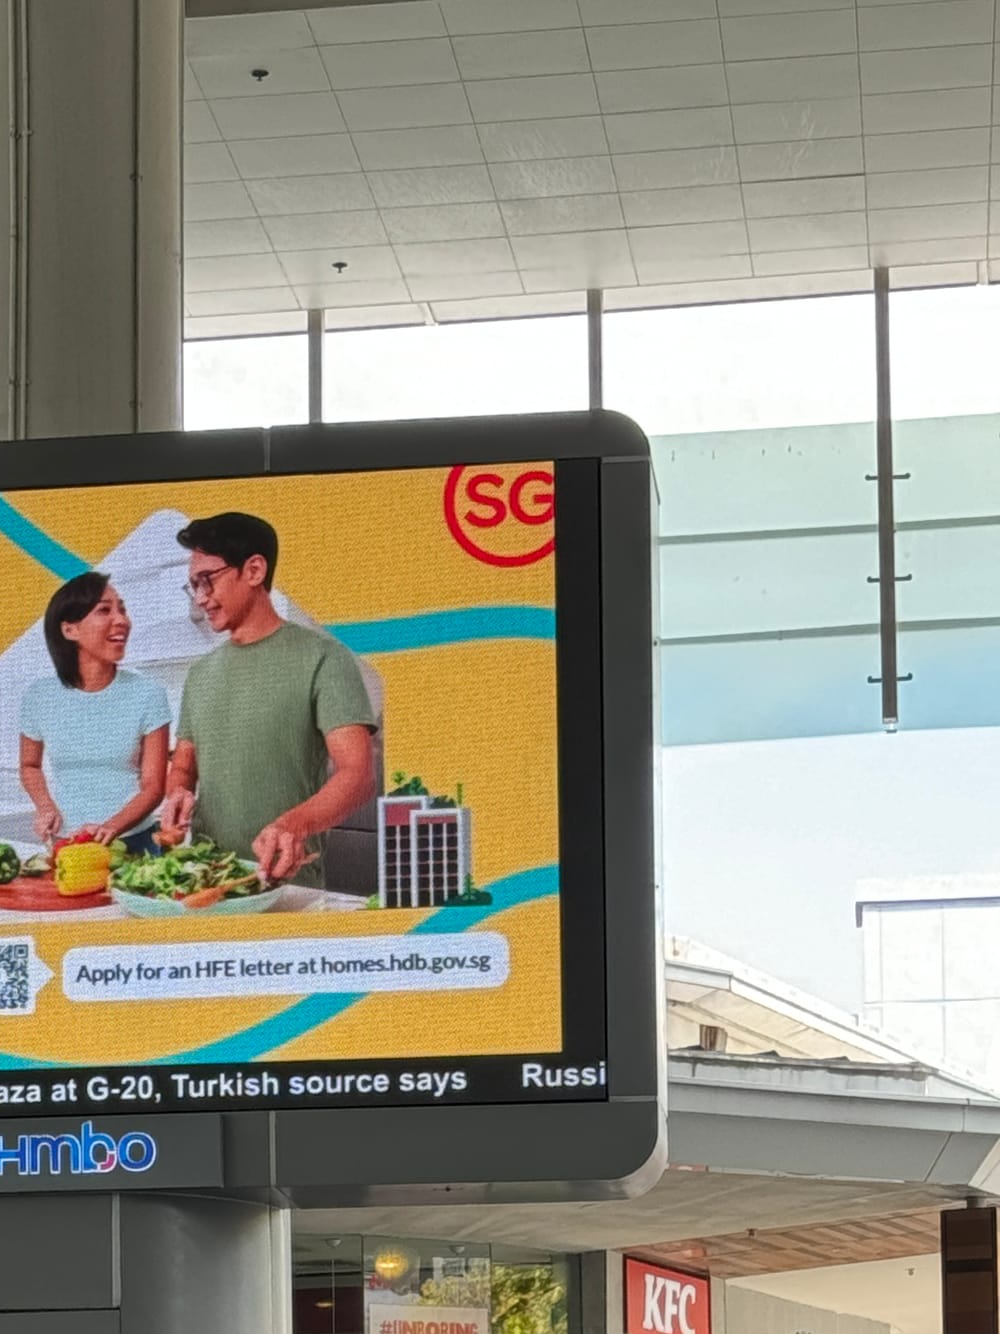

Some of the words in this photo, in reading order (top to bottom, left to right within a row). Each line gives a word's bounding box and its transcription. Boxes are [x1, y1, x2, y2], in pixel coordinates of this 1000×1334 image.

[464, 470, 555, 529] SG
[76, 965, 132, 986] Apply
[136, 961, 162, 981] for
[168, 963, 191, 979] an
[196, 959, 235, 979] HFE
[239, 957, 294, 977] letter
[297, 957, 318, 975] at
[320, 950, 490, 974] homes.hdb.gov.sg
[51, 1079, 77, 1102] at
[87, 1075, 161, 1103] G-20,
[171, 1069, 279, 1099] Turkish
[288, 1070, 390, 1095] source
[398, 1068, 467, 1096] says
[521, 1061, 606, 1089] Russi
